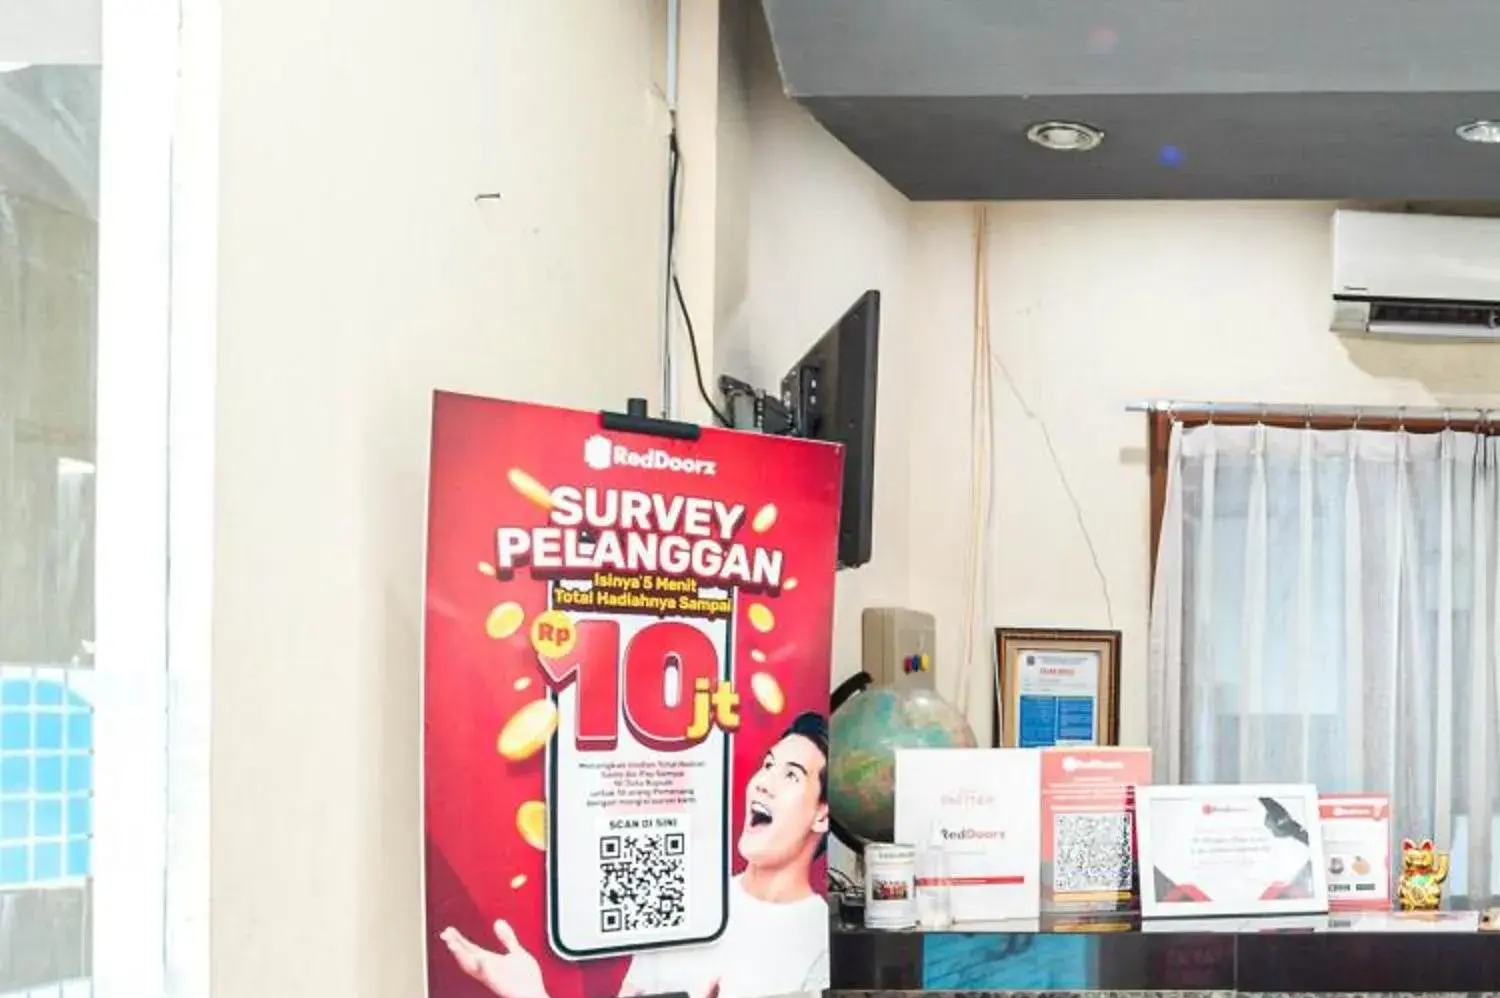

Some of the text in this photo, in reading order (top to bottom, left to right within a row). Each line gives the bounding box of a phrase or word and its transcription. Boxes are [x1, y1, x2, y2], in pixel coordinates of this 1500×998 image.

[613, 446, 717, 476] RedDoorz
[549, 485, 745, 540] SURVEY
[496, 527, 784, 588] PELANGGAN
[656, 576, 698, 593] Menit
[554, 588, 732, 615] Total Hadiahnya Sampai
[537, 622, 571, 649] Rp
[609, 818, 678, 830] SCAN DI SINI
